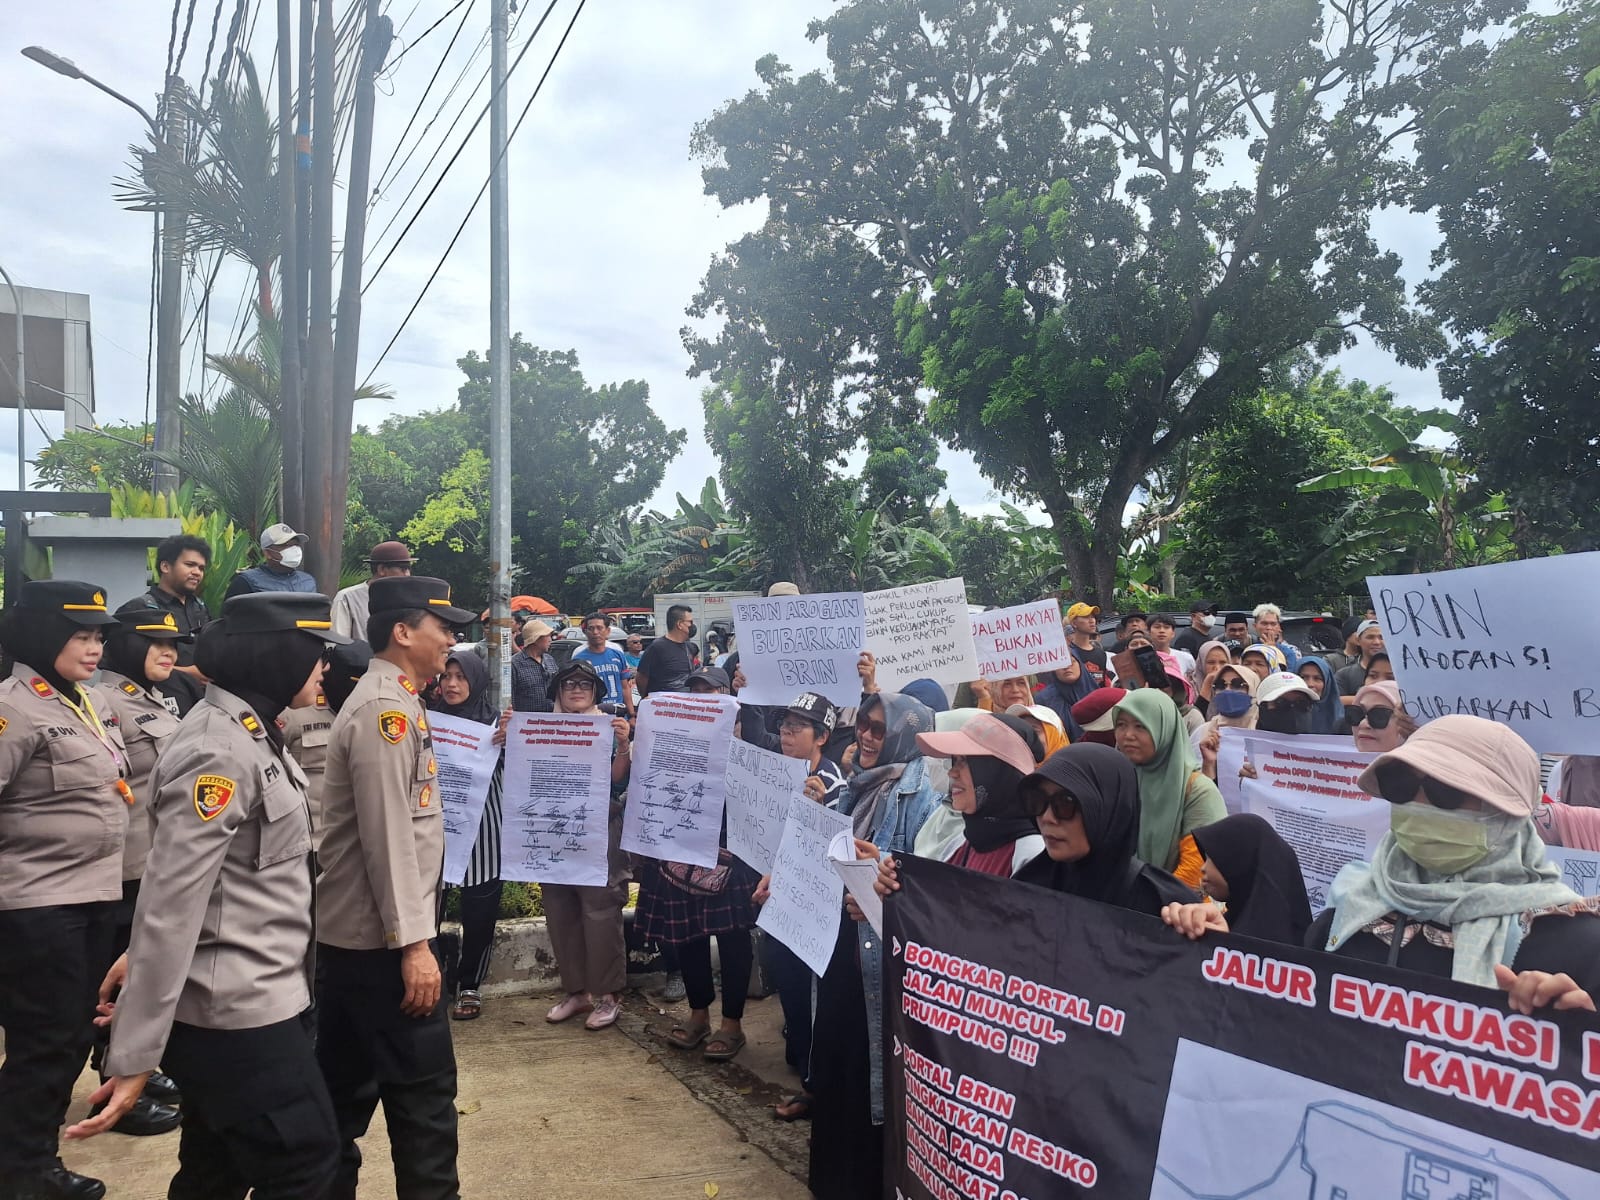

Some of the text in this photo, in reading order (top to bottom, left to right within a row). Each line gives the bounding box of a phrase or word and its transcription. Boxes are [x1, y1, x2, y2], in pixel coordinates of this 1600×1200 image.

[737, 599, 860, 621] BRIN AROGAN
[916, 607, 947, 619] CUKUP
[972, 608, 1057, 636] JALAN RAKYAT
[752, 627, 861, 655] BUBARKAN
[931, 641, 955, 654] AKAN
[994, 631, 1043, 653] BUKAN
[778, 659, 838, 687] BRIN
[979, 656, 1018, 676] JALAN
[1398, 688, 1553, 722] BUBARKAN
[903, 968, 966, 1009] JALAN
[904, 942, 1126, 1035] BONGKAR PORTAL DI
[902, 992, 1008, 1053] PRUMPUNG
[1203, 947, 1315, 1006] JALUR
[1330, 975, 1559, 1069] EVAKUASI
[903, 1043, 1016, 1120] PORTAL BRIN
[904, 1068, 1098, 1188] TINGKATKAN RESIKO
[905, 1095, 1005, 1181] BAHAYA PADA
[906, 1119, 1000, 1200] MASYARAKAT
